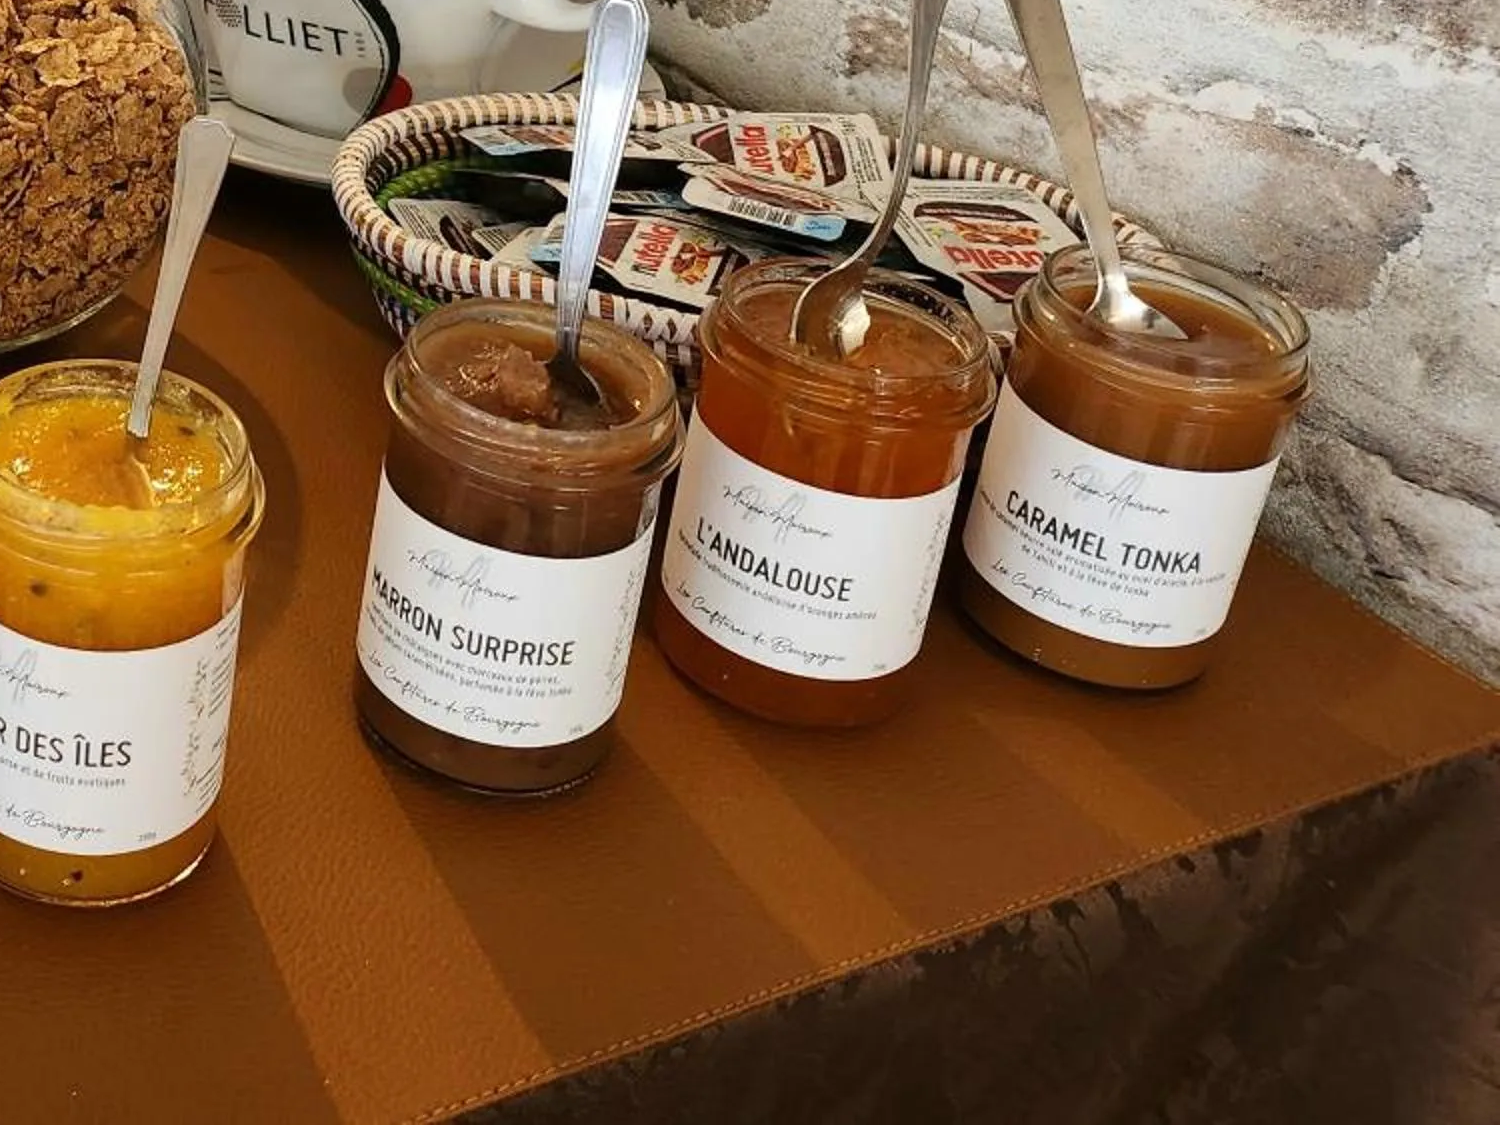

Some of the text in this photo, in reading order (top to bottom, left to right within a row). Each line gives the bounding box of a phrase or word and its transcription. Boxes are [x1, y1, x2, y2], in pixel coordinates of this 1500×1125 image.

[735, 124, 775, 174] utella
[942, 245, 1046, 270] utella
[697, 516, 855, 602] L'ANDALOUSE
[1006, 490, 1108, 562] CARAMEL
[1121, 543, 1201, 574] TONKA
[371, 565, 443, 642] MARRON
[451, 624, 576, 667] SURPRISE
[15, 726, 65, 764] DES
[73, 734, 132, 768] ÎLES
